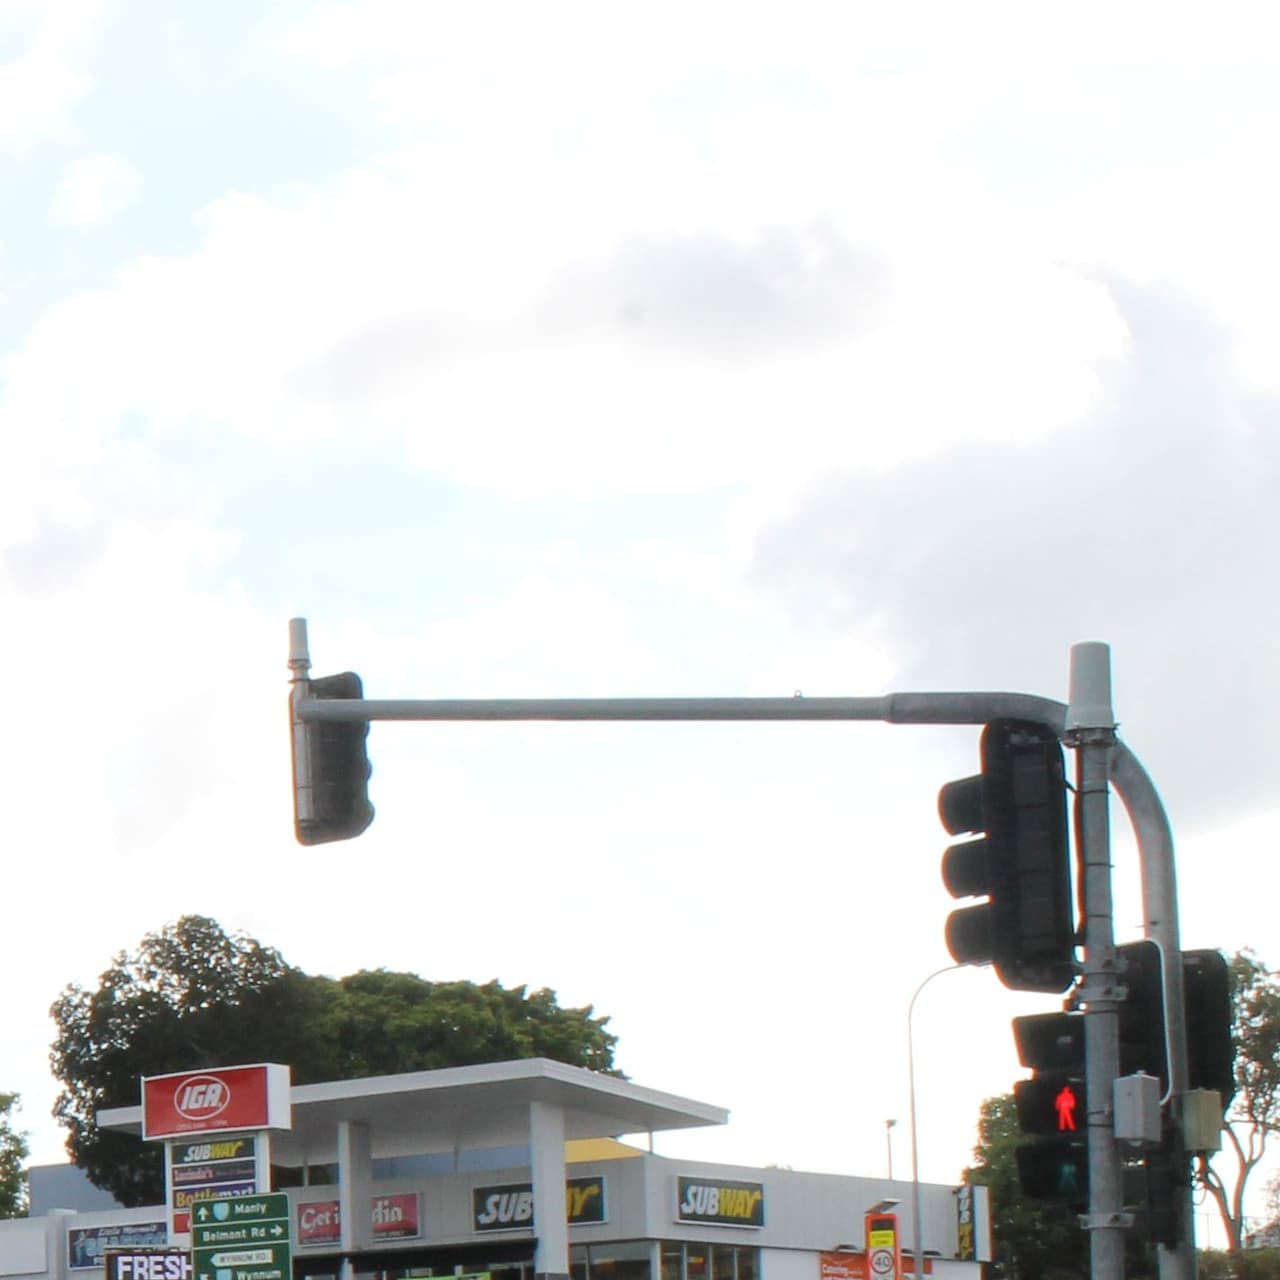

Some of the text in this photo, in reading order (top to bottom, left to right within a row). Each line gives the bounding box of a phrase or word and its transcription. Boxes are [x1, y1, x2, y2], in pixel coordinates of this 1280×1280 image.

[181, 1083, 223, 1110] IGA
[184, 1141, 243, 1161] SUBWAY
[234, 1204, 267, 1214] Manly
[681, 1185, 761, 1218] SUBWAY
[301, 1208, 331, 1233] Get
[203, 1227, 266, 1242] Belmont Rd
[874, 1256, 890, 1268] 40
